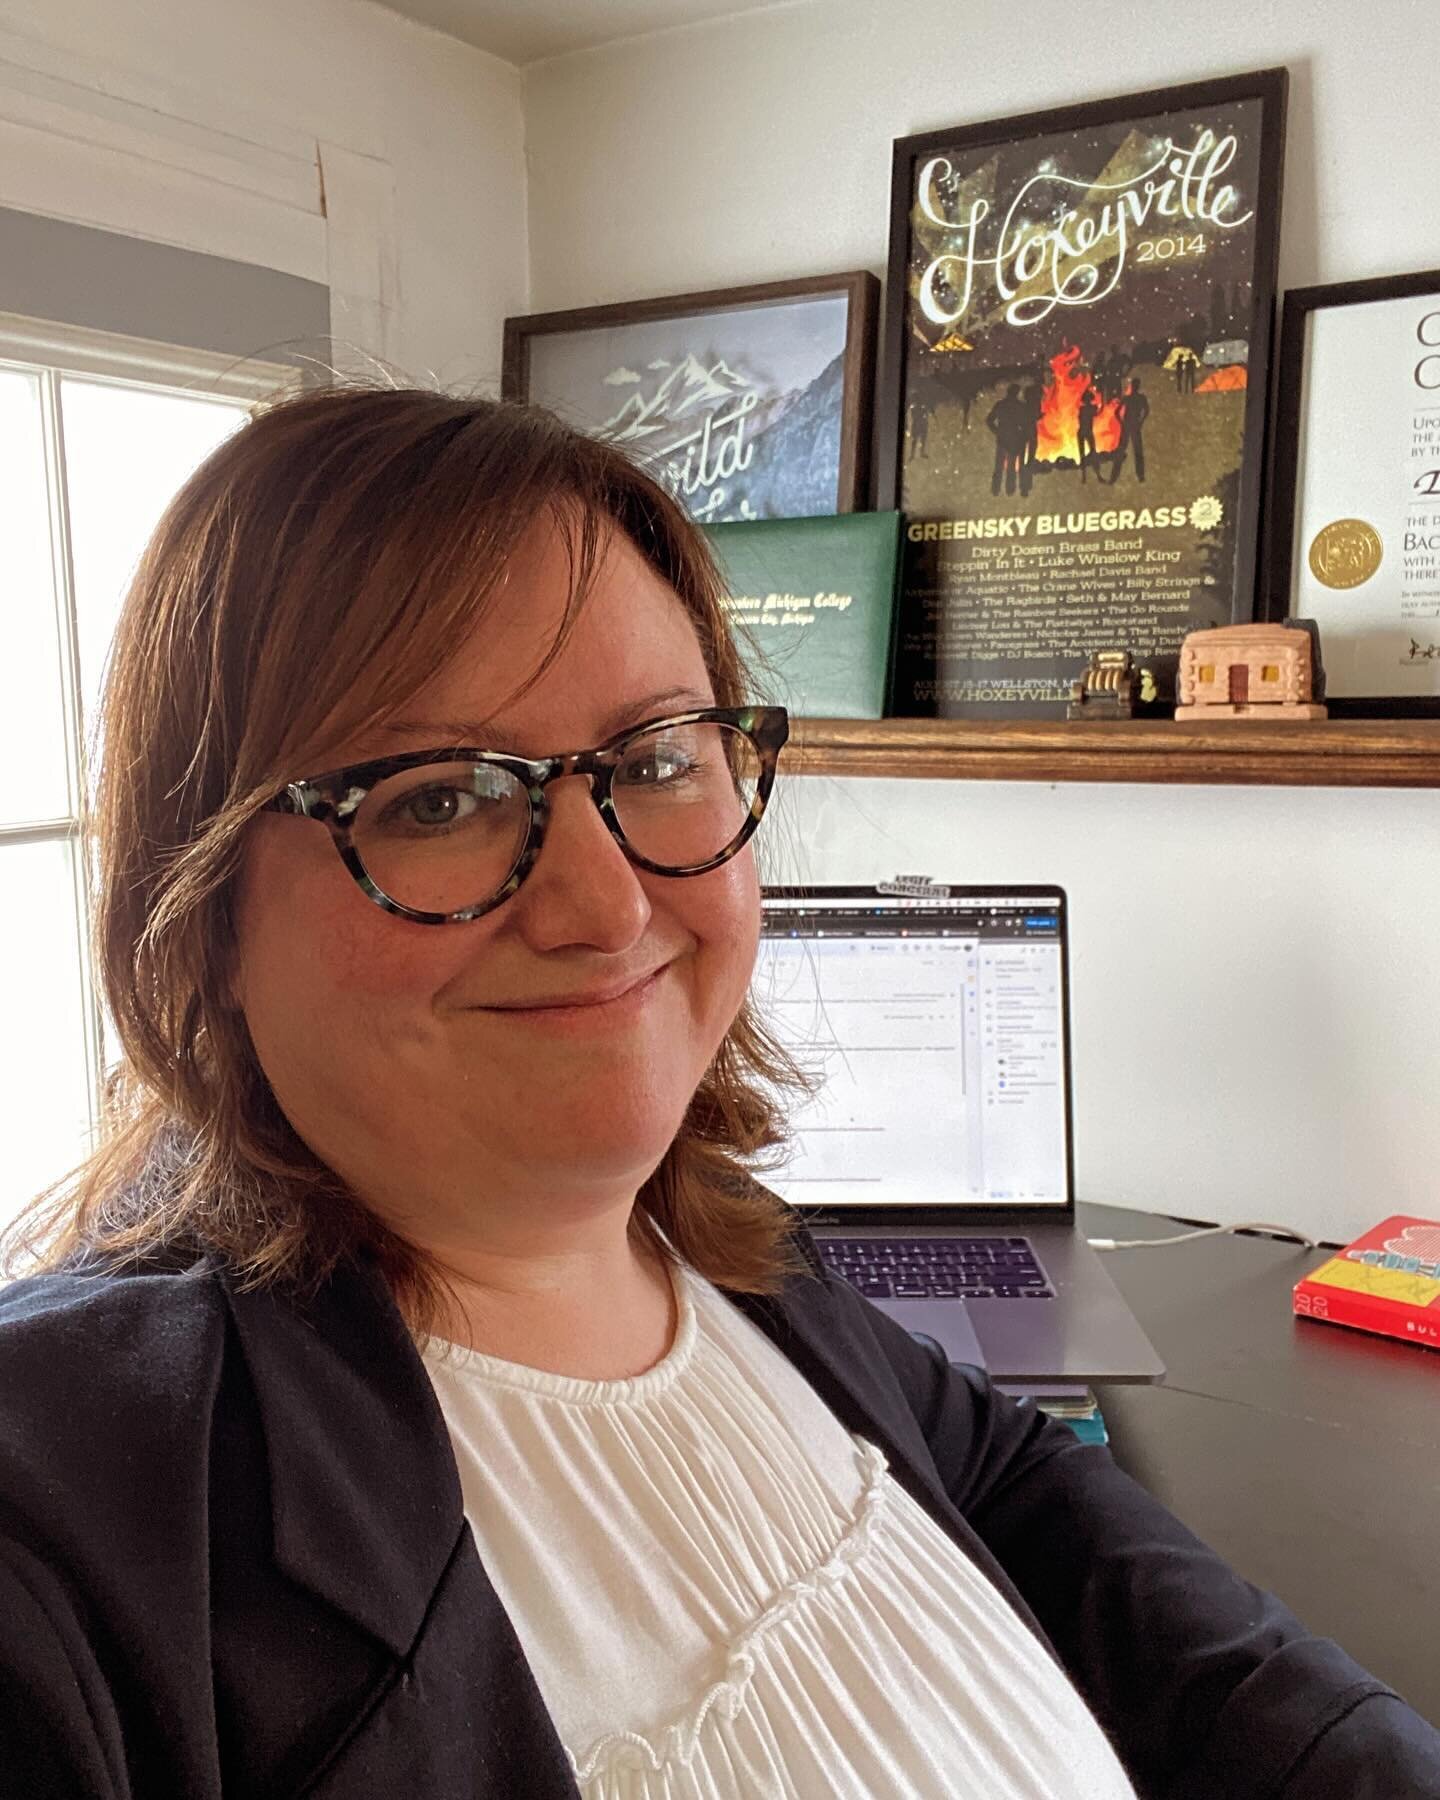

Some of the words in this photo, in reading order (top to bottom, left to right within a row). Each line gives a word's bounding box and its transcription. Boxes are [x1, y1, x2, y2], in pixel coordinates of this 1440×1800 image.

[919, 128, 1254, 327] Hoxeyville
[1136, 233, 1207, 263] 2014
[908, 515, 1031, 542] GREENSKY
[1036, 506, 1187, 535] BLUEGRASS
[971, 546, 1008, 560] Dirty
[1010, 544, 1056, 557] Dozen
[1058, 540, 1101, 554] Brass
[1104, 536, 1144, 551] Band
[995, 557, 1010, 570] In
[1013, 556, 1026, 568] It
[1037, 553, 1075, 568] Luke
[1077, 550, 1142, 566] Winslow
[1145, 549, 1182, 563] King
[1134, 563, 1168, 576] Band
[1018, 583, 1040, 593] The
[1042, 581, 1078, 592] Crane
[1126, 577, 1152, 589] Billy
[1155, 576, 1201, 588] Strings
[814, 592, 852, 611] College
[1066, 593, 1094, 604] Seth
[1097, 593, 1108, 603] &
[1111, 591, 1138, 603] May
[1141, 589, 1191, 601] Bernard
[1006, 650, 1022, 659] DJ
